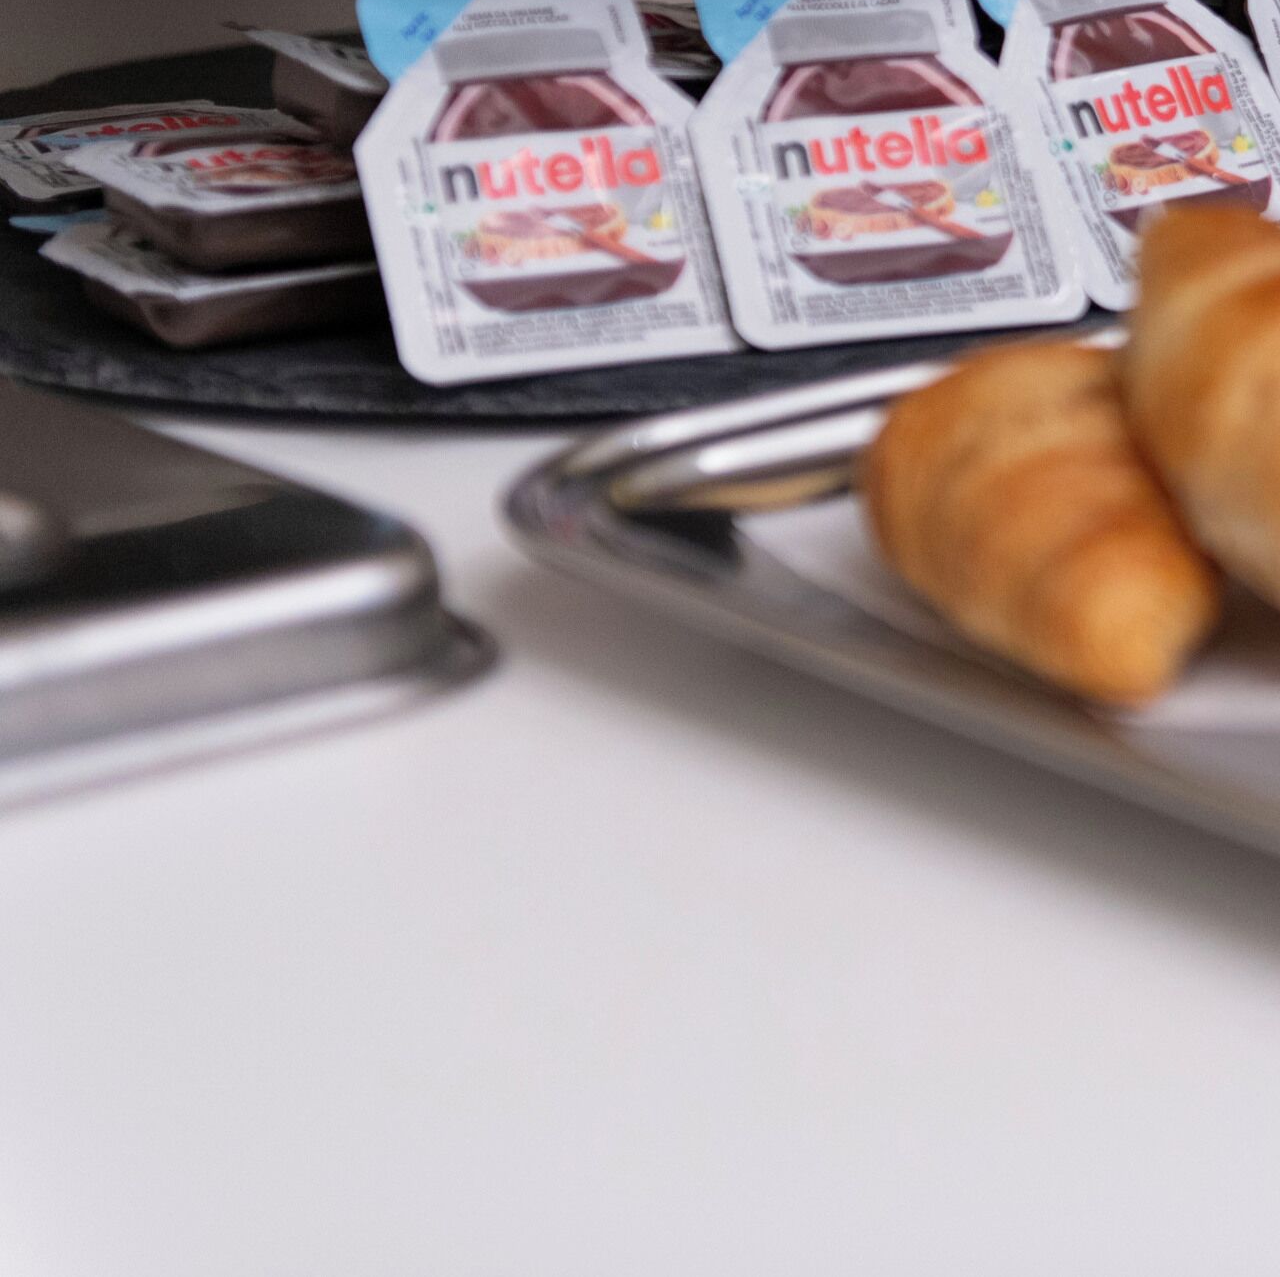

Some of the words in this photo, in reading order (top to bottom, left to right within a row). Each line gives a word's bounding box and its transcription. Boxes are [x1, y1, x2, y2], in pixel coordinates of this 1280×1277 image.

[1068, 64, 1233, 138] nutella
[439, 134, 662, 204] nutella
[773, 114, 990, 180] nutella
